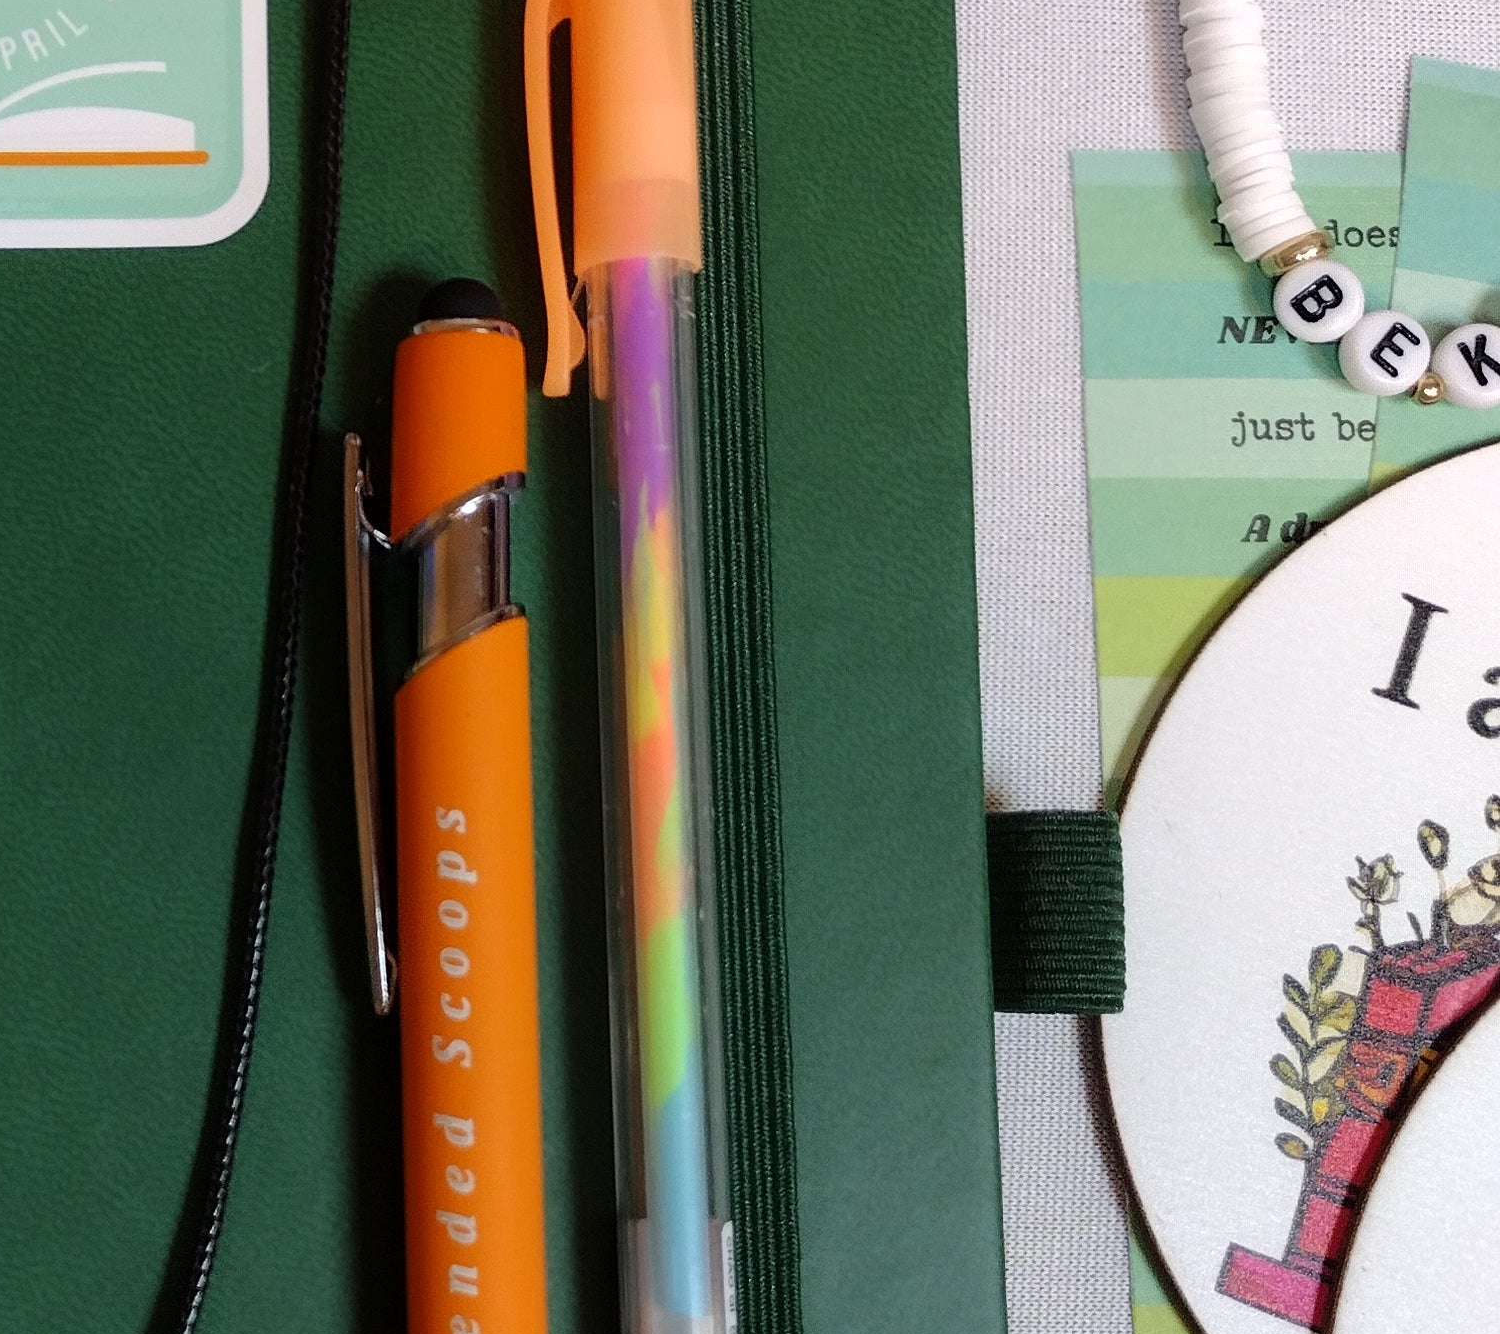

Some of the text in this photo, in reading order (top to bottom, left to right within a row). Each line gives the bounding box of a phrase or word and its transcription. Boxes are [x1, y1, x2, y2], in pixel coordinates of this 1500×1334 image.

[1230, 411, 1376, 448] just be
[1371, 592, 1450, 711] I
[431, 806, 479, 1069] Scoops
